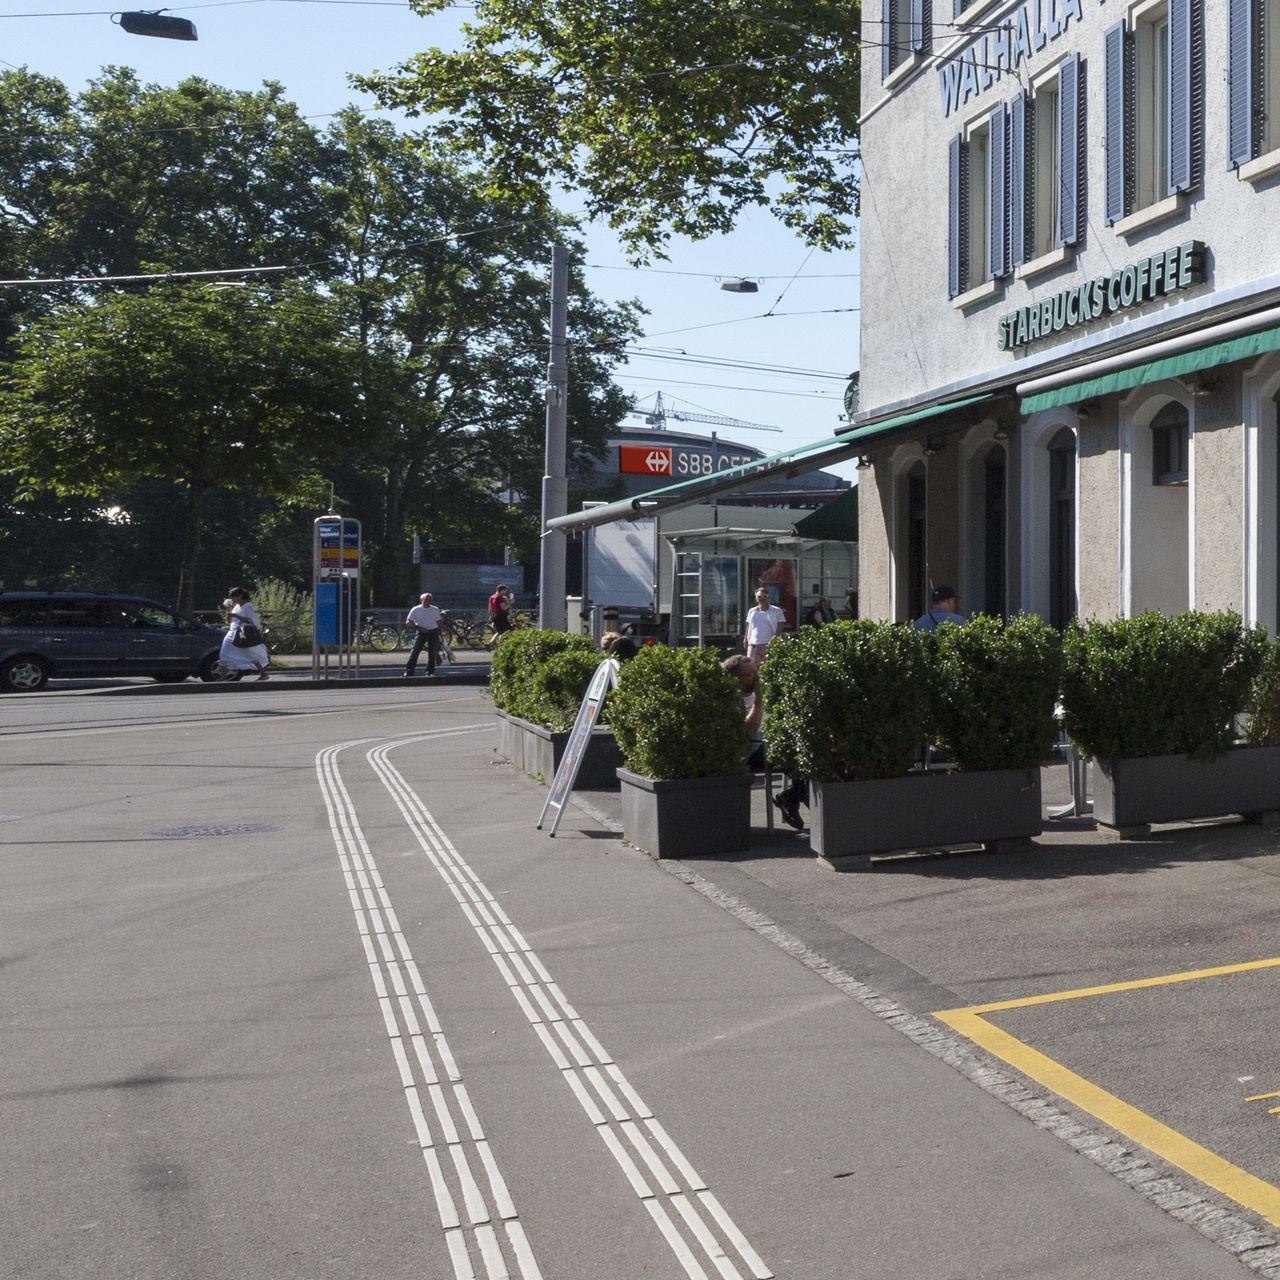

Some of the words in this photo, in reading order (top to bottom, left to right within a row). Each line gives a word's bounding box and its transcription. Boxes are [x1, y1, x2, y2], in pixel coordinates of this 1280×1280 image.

[999, 277, 1104, 351] STARBUCKS
[1107, 239, 1195, 311] COFFEE
[677, 452, 713, 475] SBB
